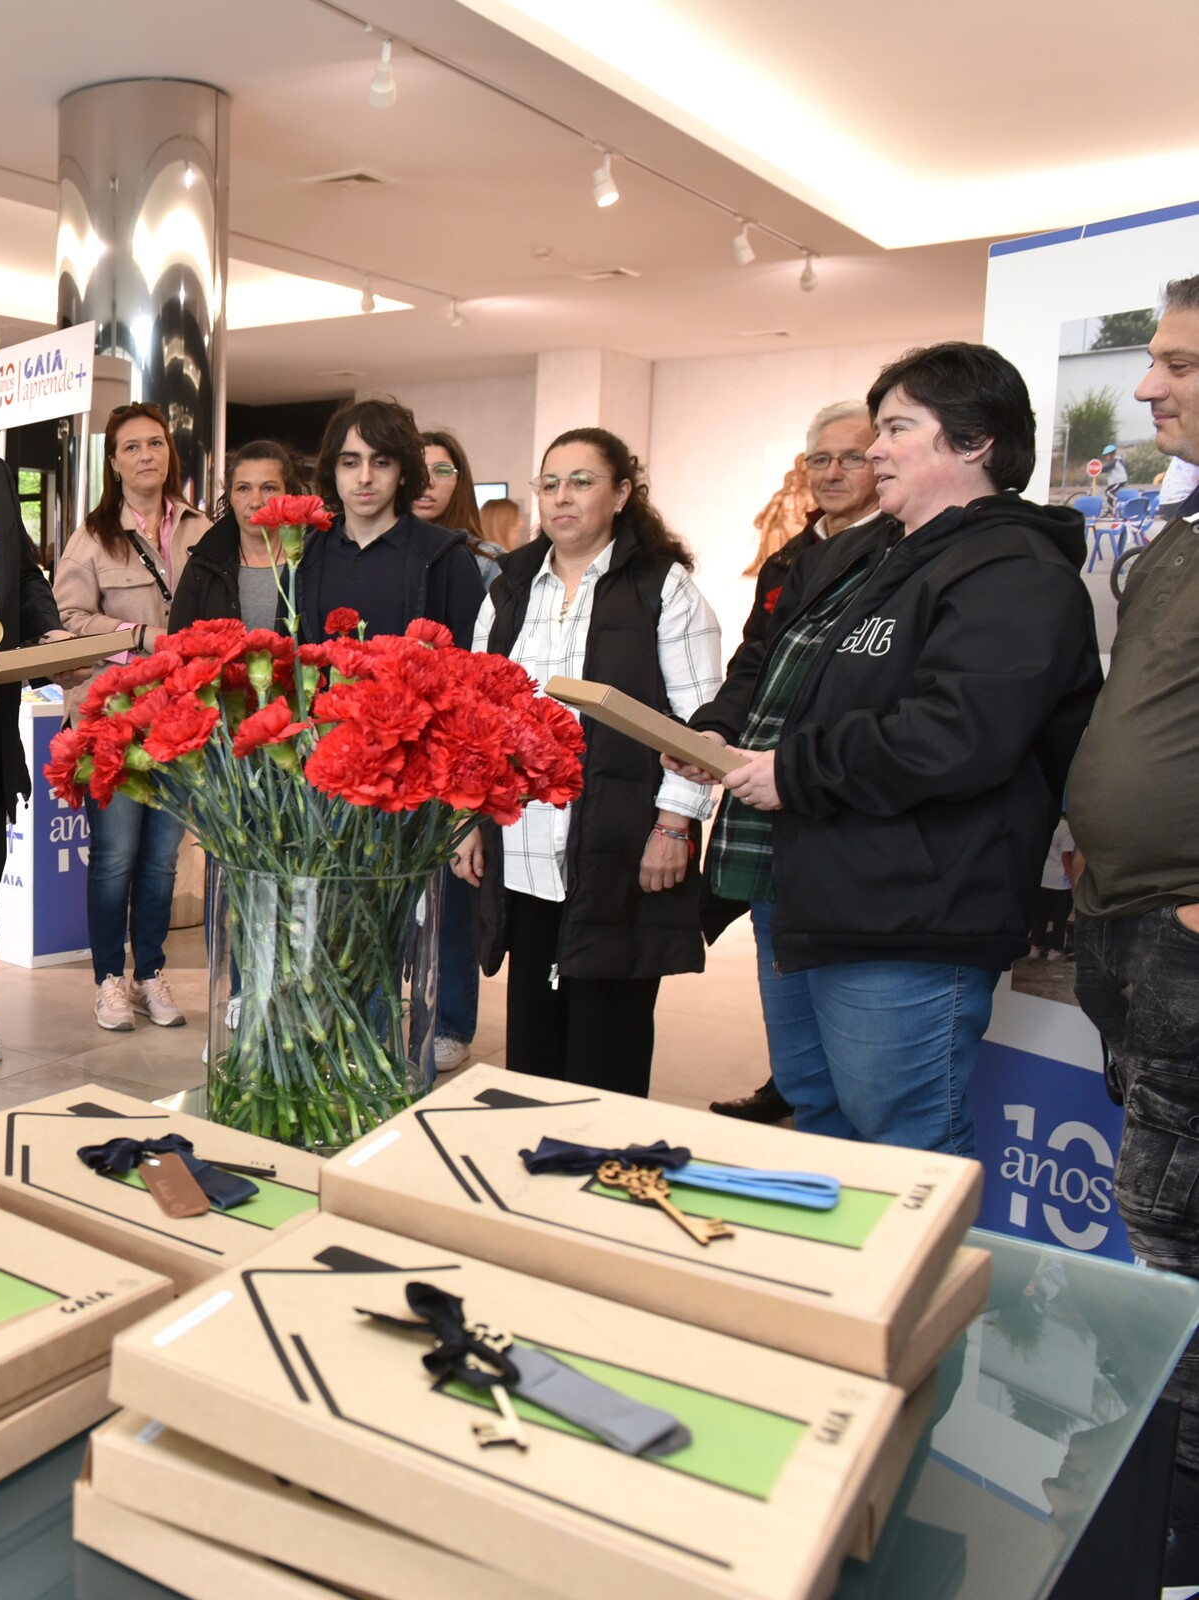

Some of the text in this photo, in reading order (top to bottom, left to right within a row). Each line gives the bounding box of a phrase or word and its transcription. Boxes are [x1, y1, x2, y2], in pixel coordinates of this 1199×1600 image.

[24, 349, 63, 379] GAIA
[1000, 1146, 1113, 1214] anos
[1003, 1104, 1114, 1251] 10
[60, 1290, 114, 1314] GAIA
